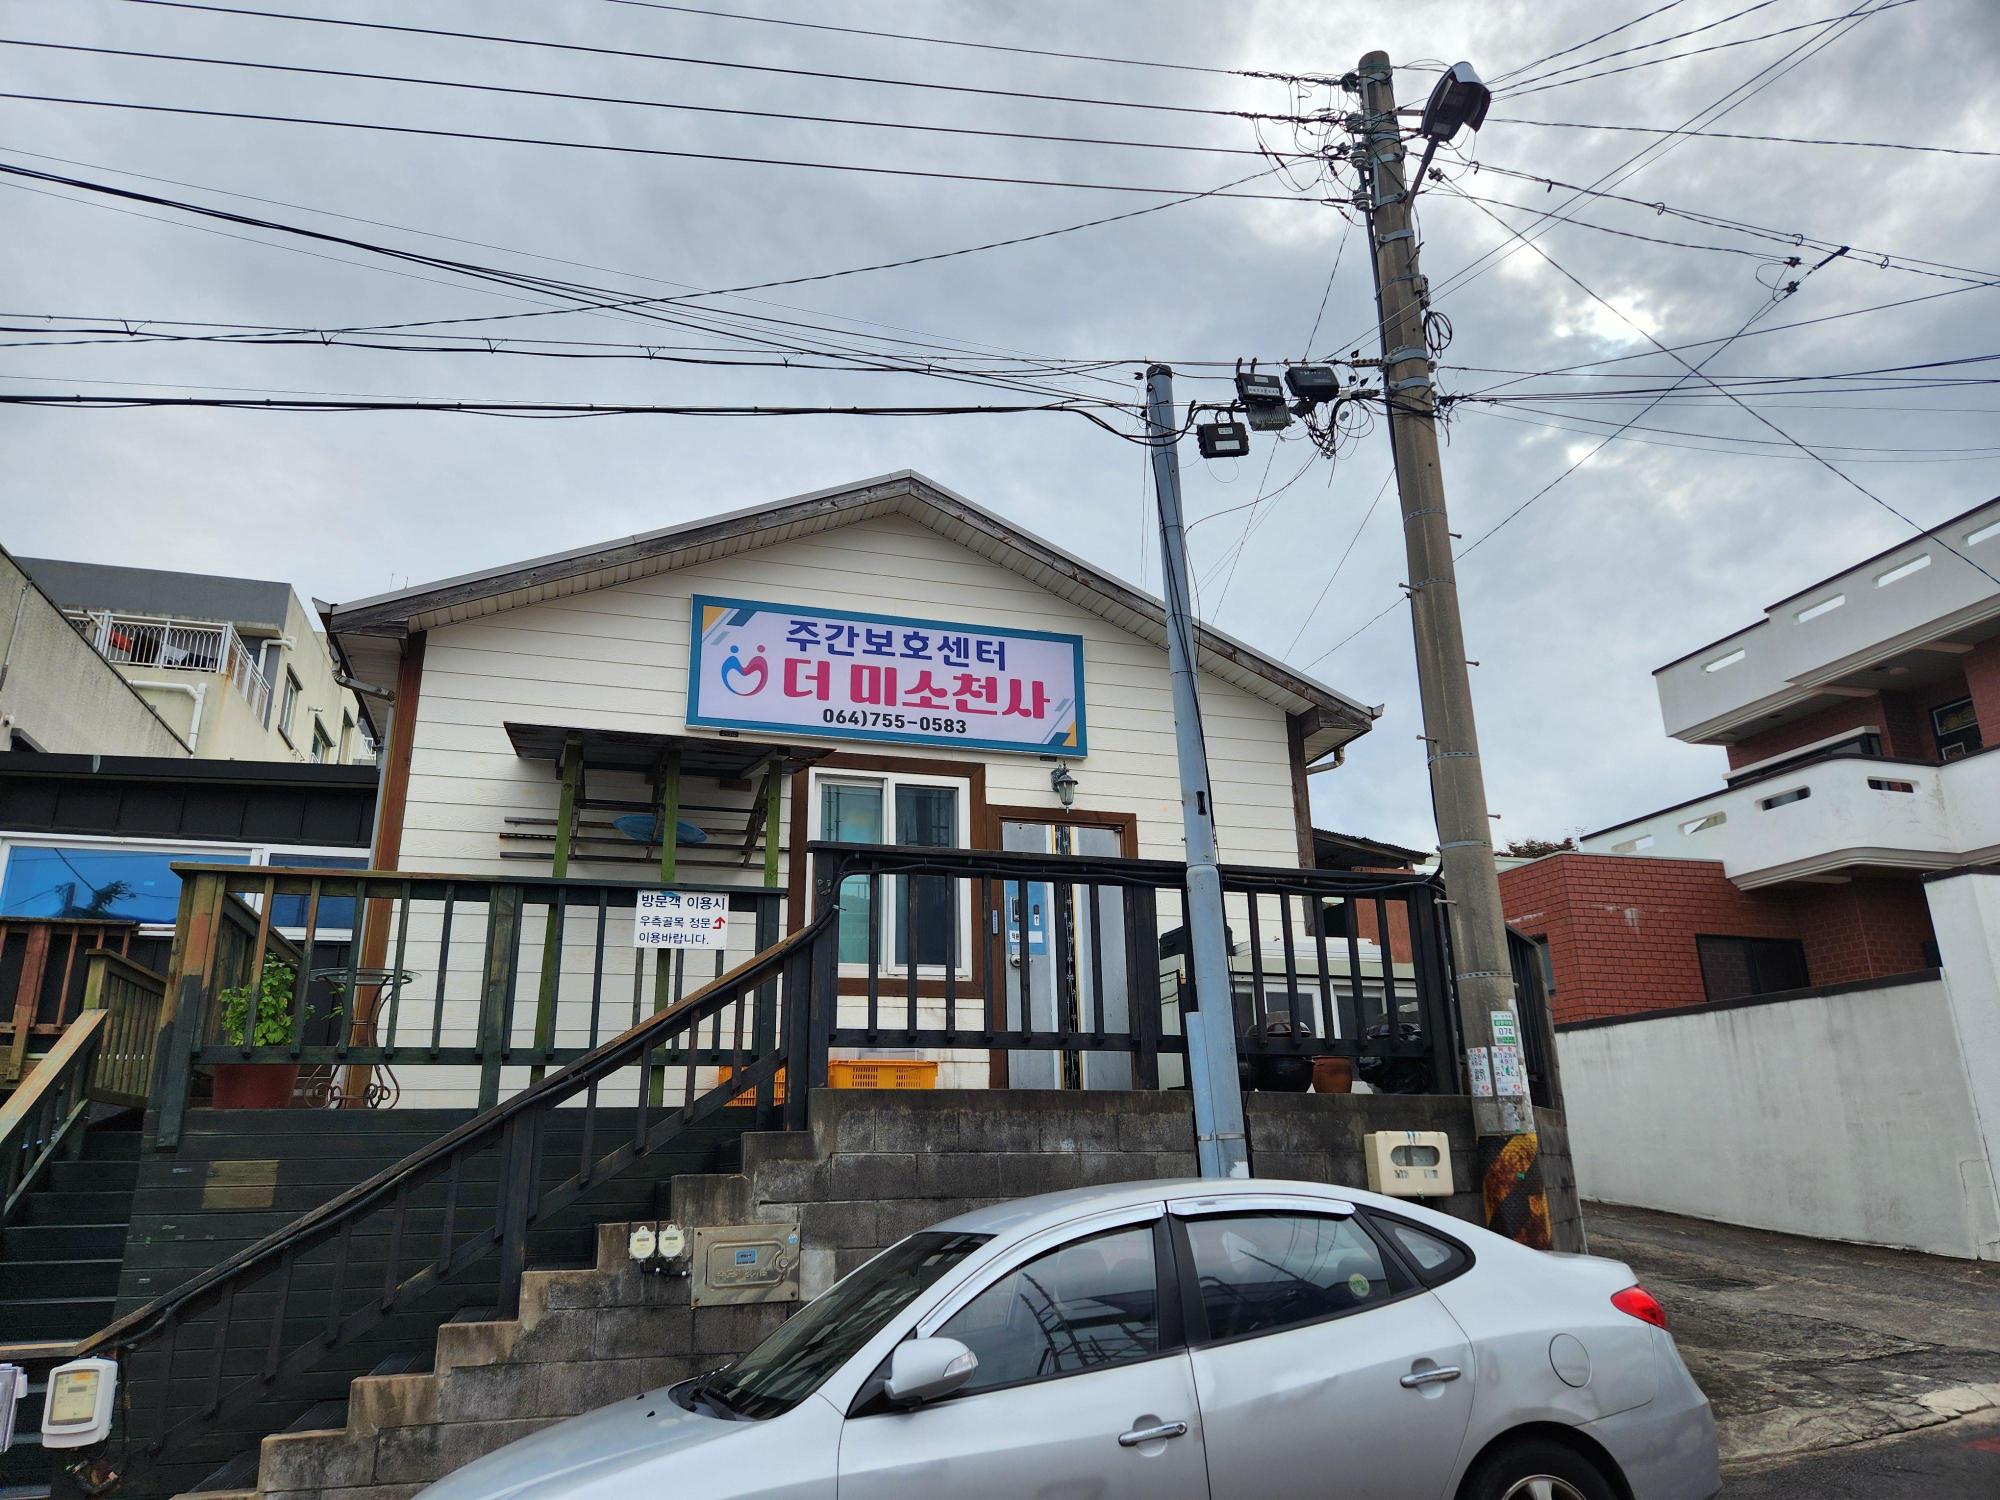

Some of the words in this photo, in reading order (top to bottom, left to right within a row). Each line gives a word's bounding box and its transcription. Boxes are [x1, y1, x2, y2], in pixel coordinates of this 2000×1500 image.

[785, 619, 1006, 672] 주간보호센터
[783, 657, 831, 701] 더
[849, 663, 1051, 720] 미소천사
[822, 708, 967, 734] 064)755-0583
[641, 894, 681, 909] 방문객
[687, 896, 725, 910] 이용시
[640, 915, 684, 928] 우측골목
[689, 917, 711, 929] 정문
[639, 932, 709, 945] 이용바랍니다.
